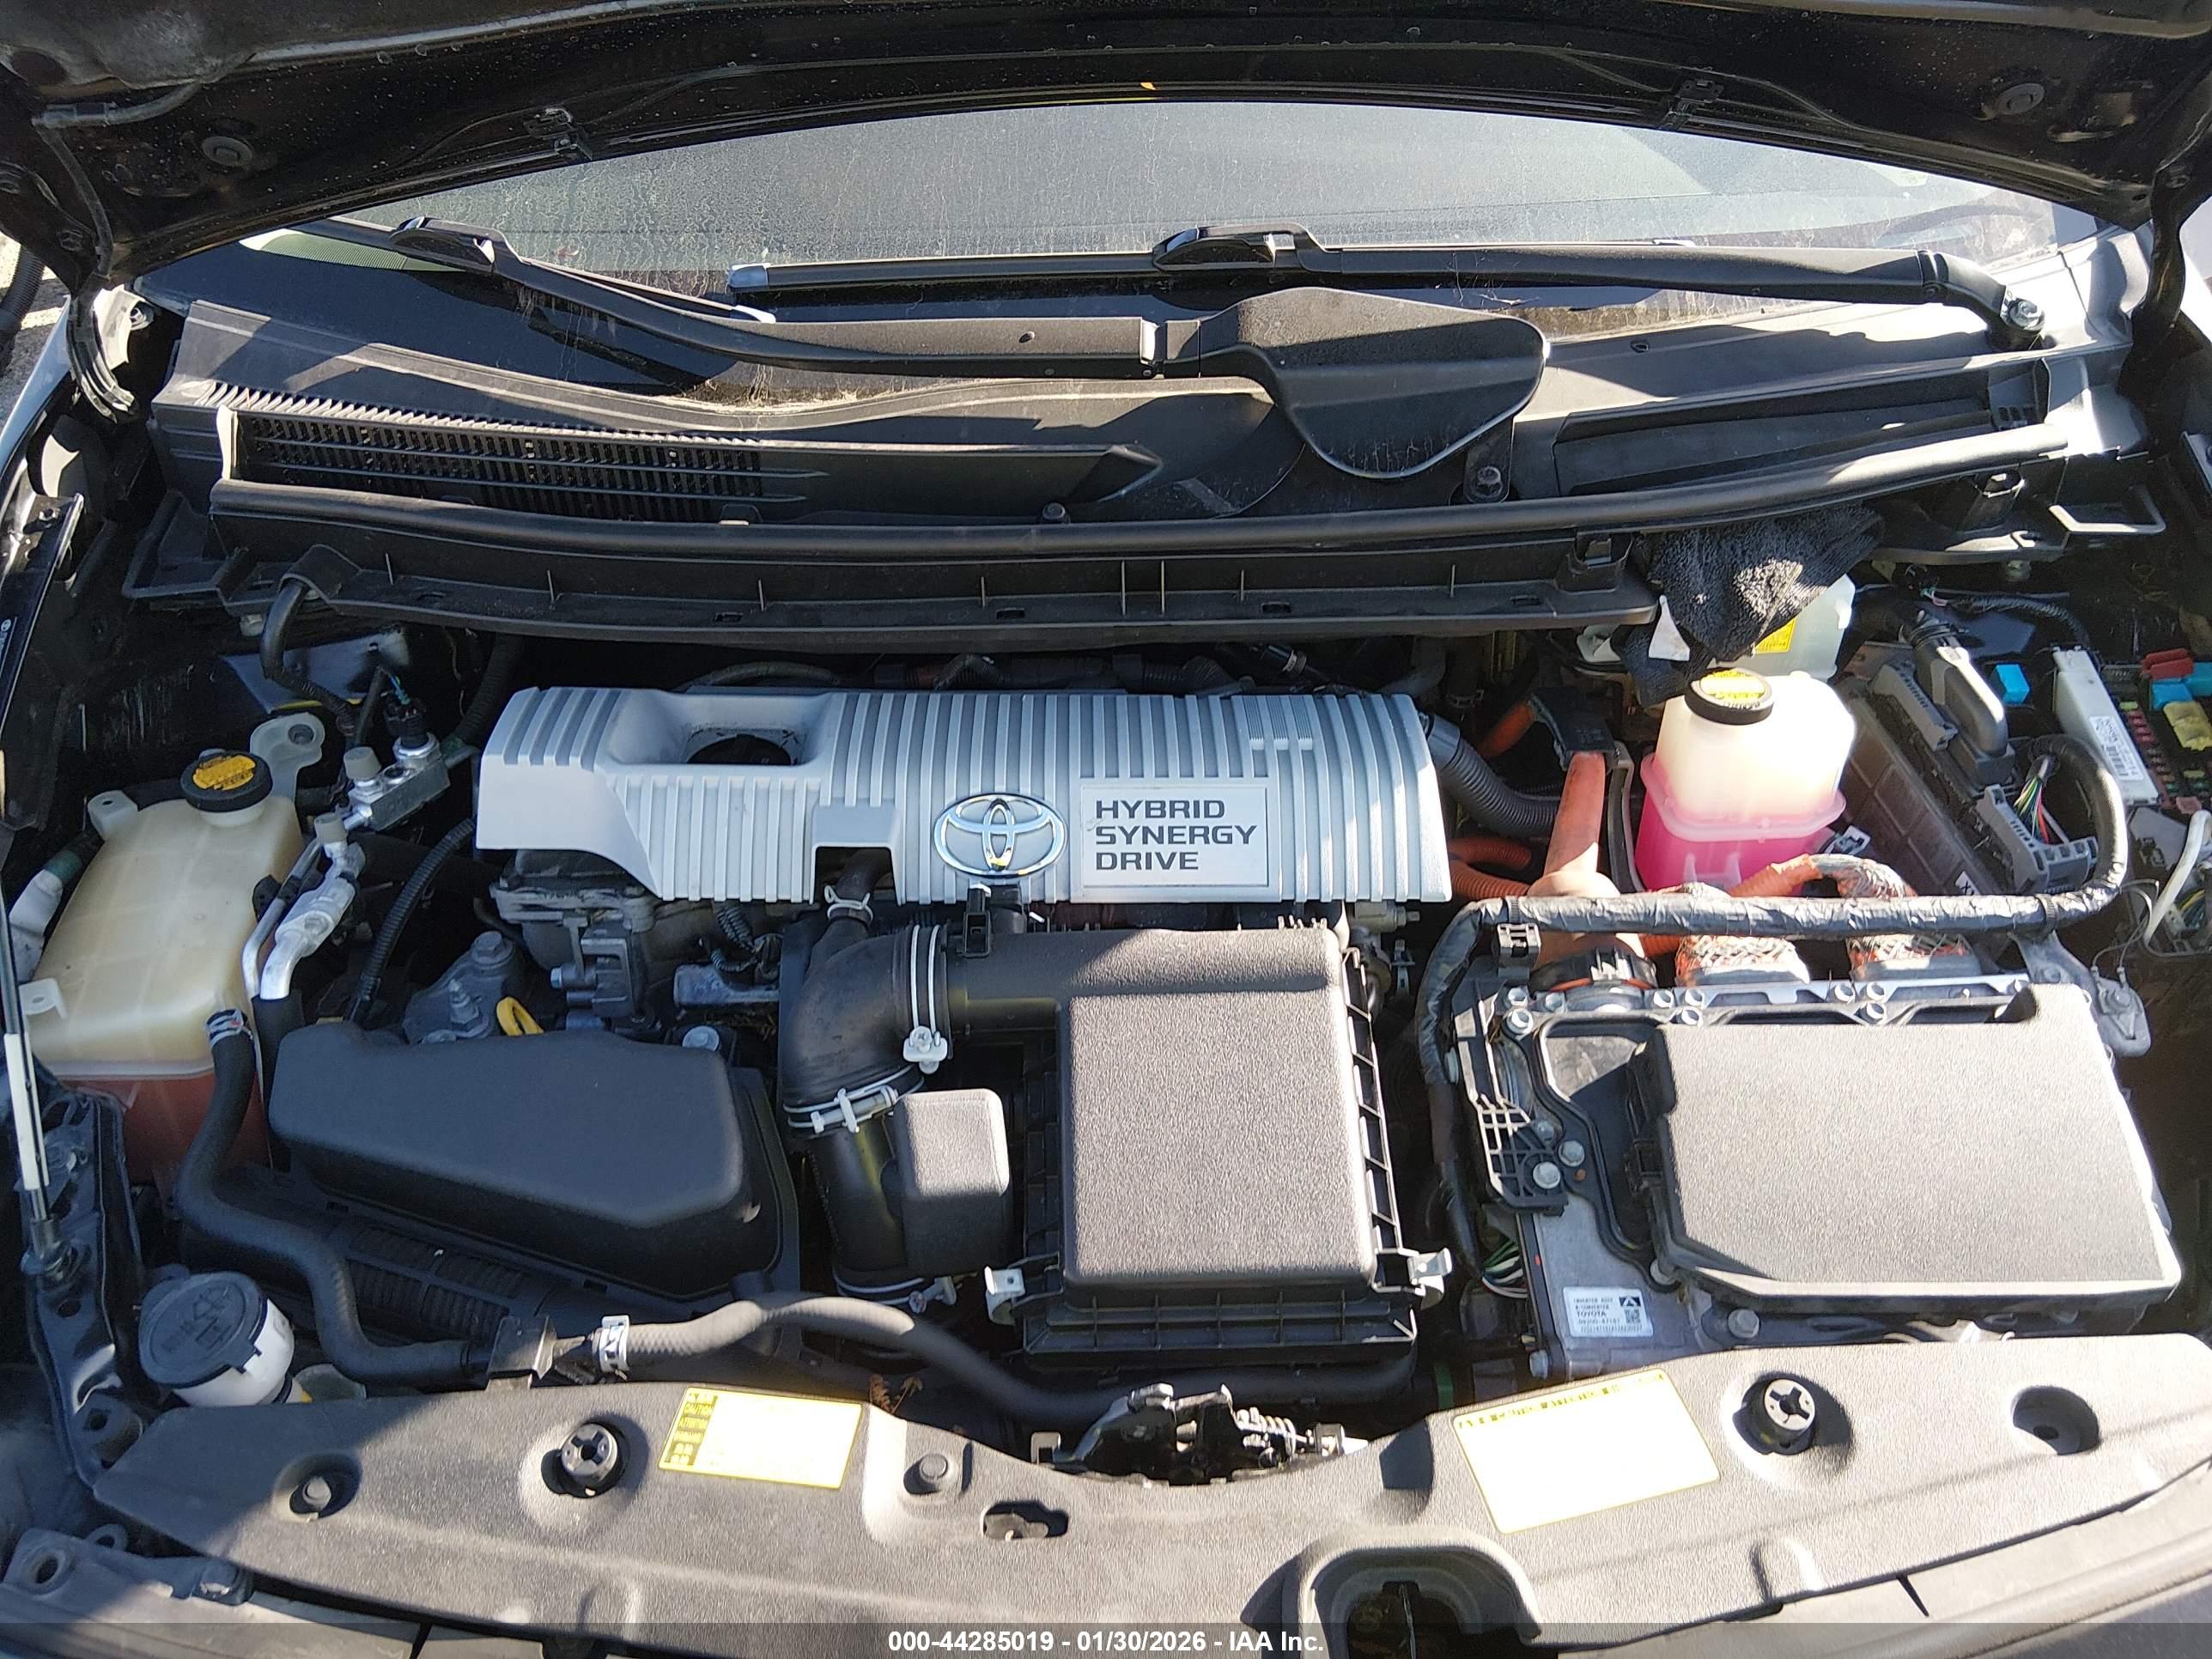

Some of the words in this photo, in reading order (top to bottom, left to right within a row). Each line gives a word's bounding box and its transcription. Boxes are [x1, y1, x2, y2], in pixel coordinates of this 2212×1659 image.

[1096, 799, 1225, 819] HYBRID
[1096, 825, 1258, 845] SYNERGY
[1096, 851, 1199, 871] DRIVE
